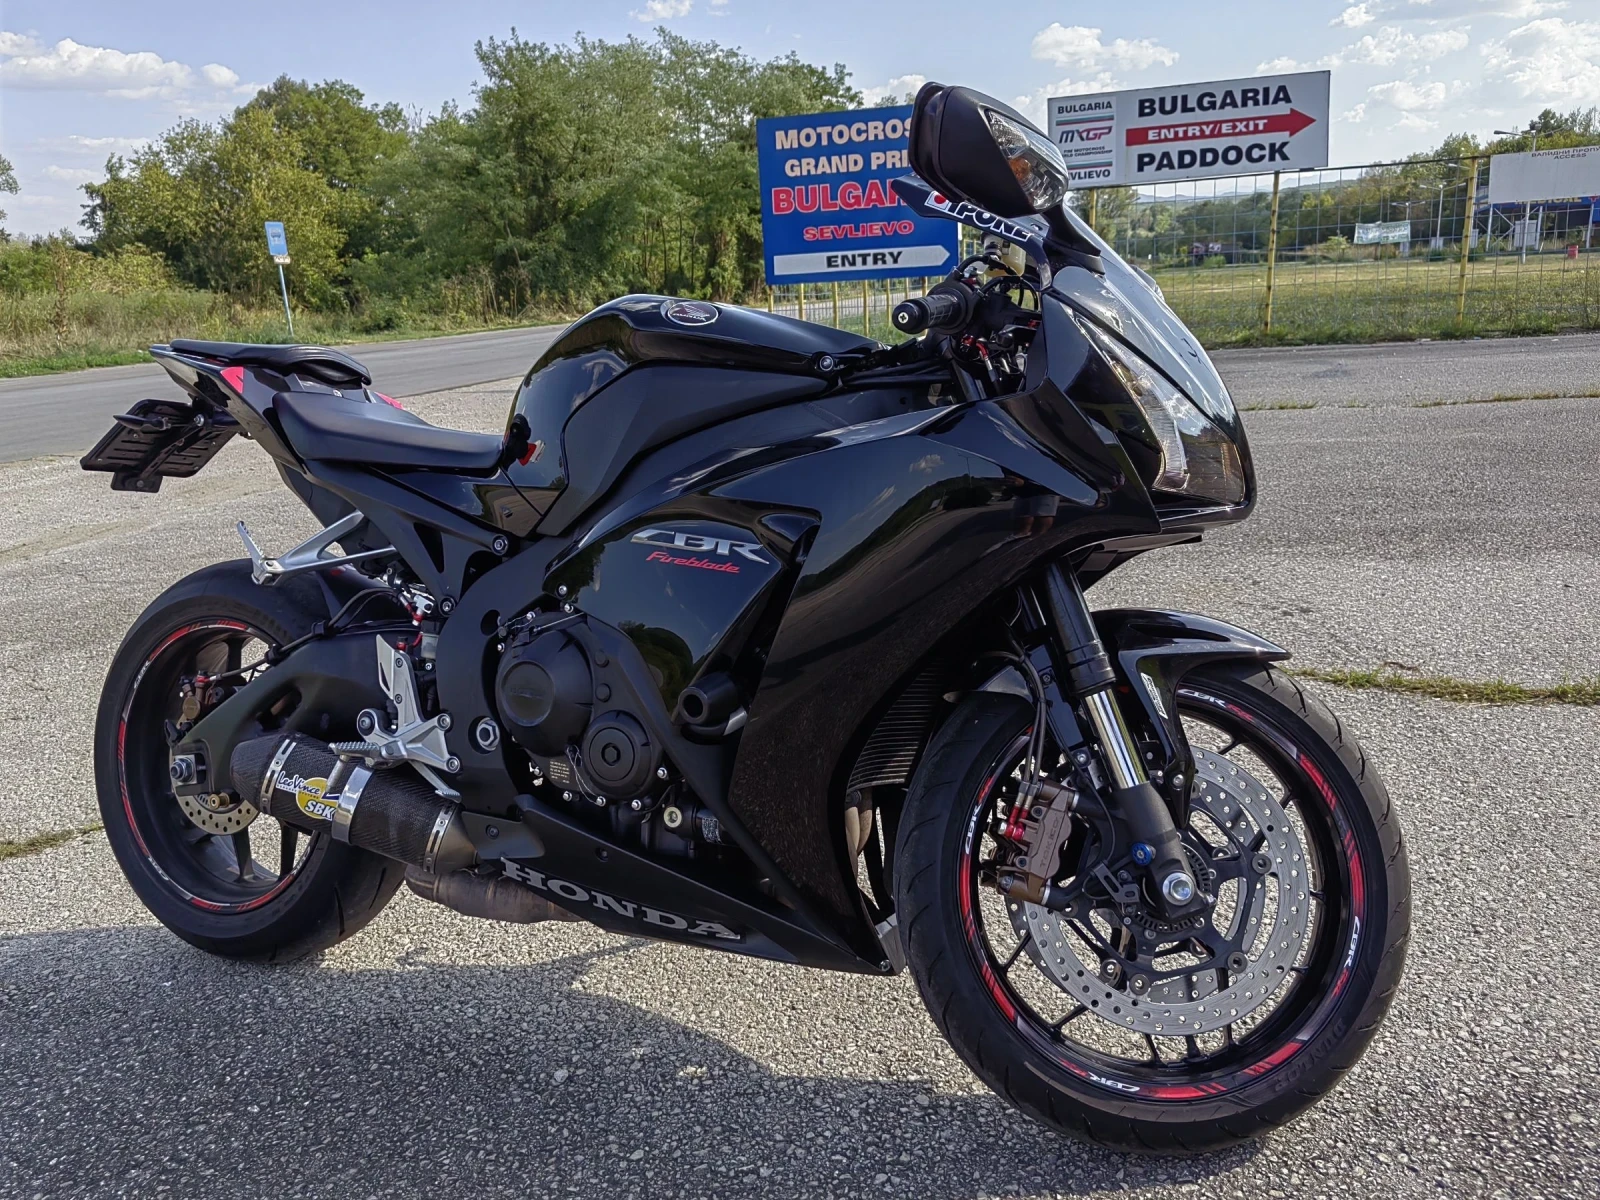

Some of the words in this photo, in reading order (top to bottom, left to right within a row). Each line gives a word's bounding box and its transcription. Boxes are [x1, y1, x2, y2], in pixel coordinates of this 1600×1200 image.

[1057, 101, 1112, 114] BULGARIA
[1138, 85, 1292, 117] BULGARIA
[1147, 119, 1268, 141] ENTRY/EXIT
[784, 154, 864, 177] GRAND
[870, 150, 911, 170] PRI
[1137, 141, 1290, 172] PADDOCK
[803, 220, 914, 241] SEVLIEVO
[826, 251, 903, 269] ENTRY
[630, 529, 770, 565] CBR
[646, 551, 740, 574] Fireblade
[277, 770, 320, 795] LeoVince
[304, 799, 336, 820] SBK
[501, 856, 741, 941] HONDA
